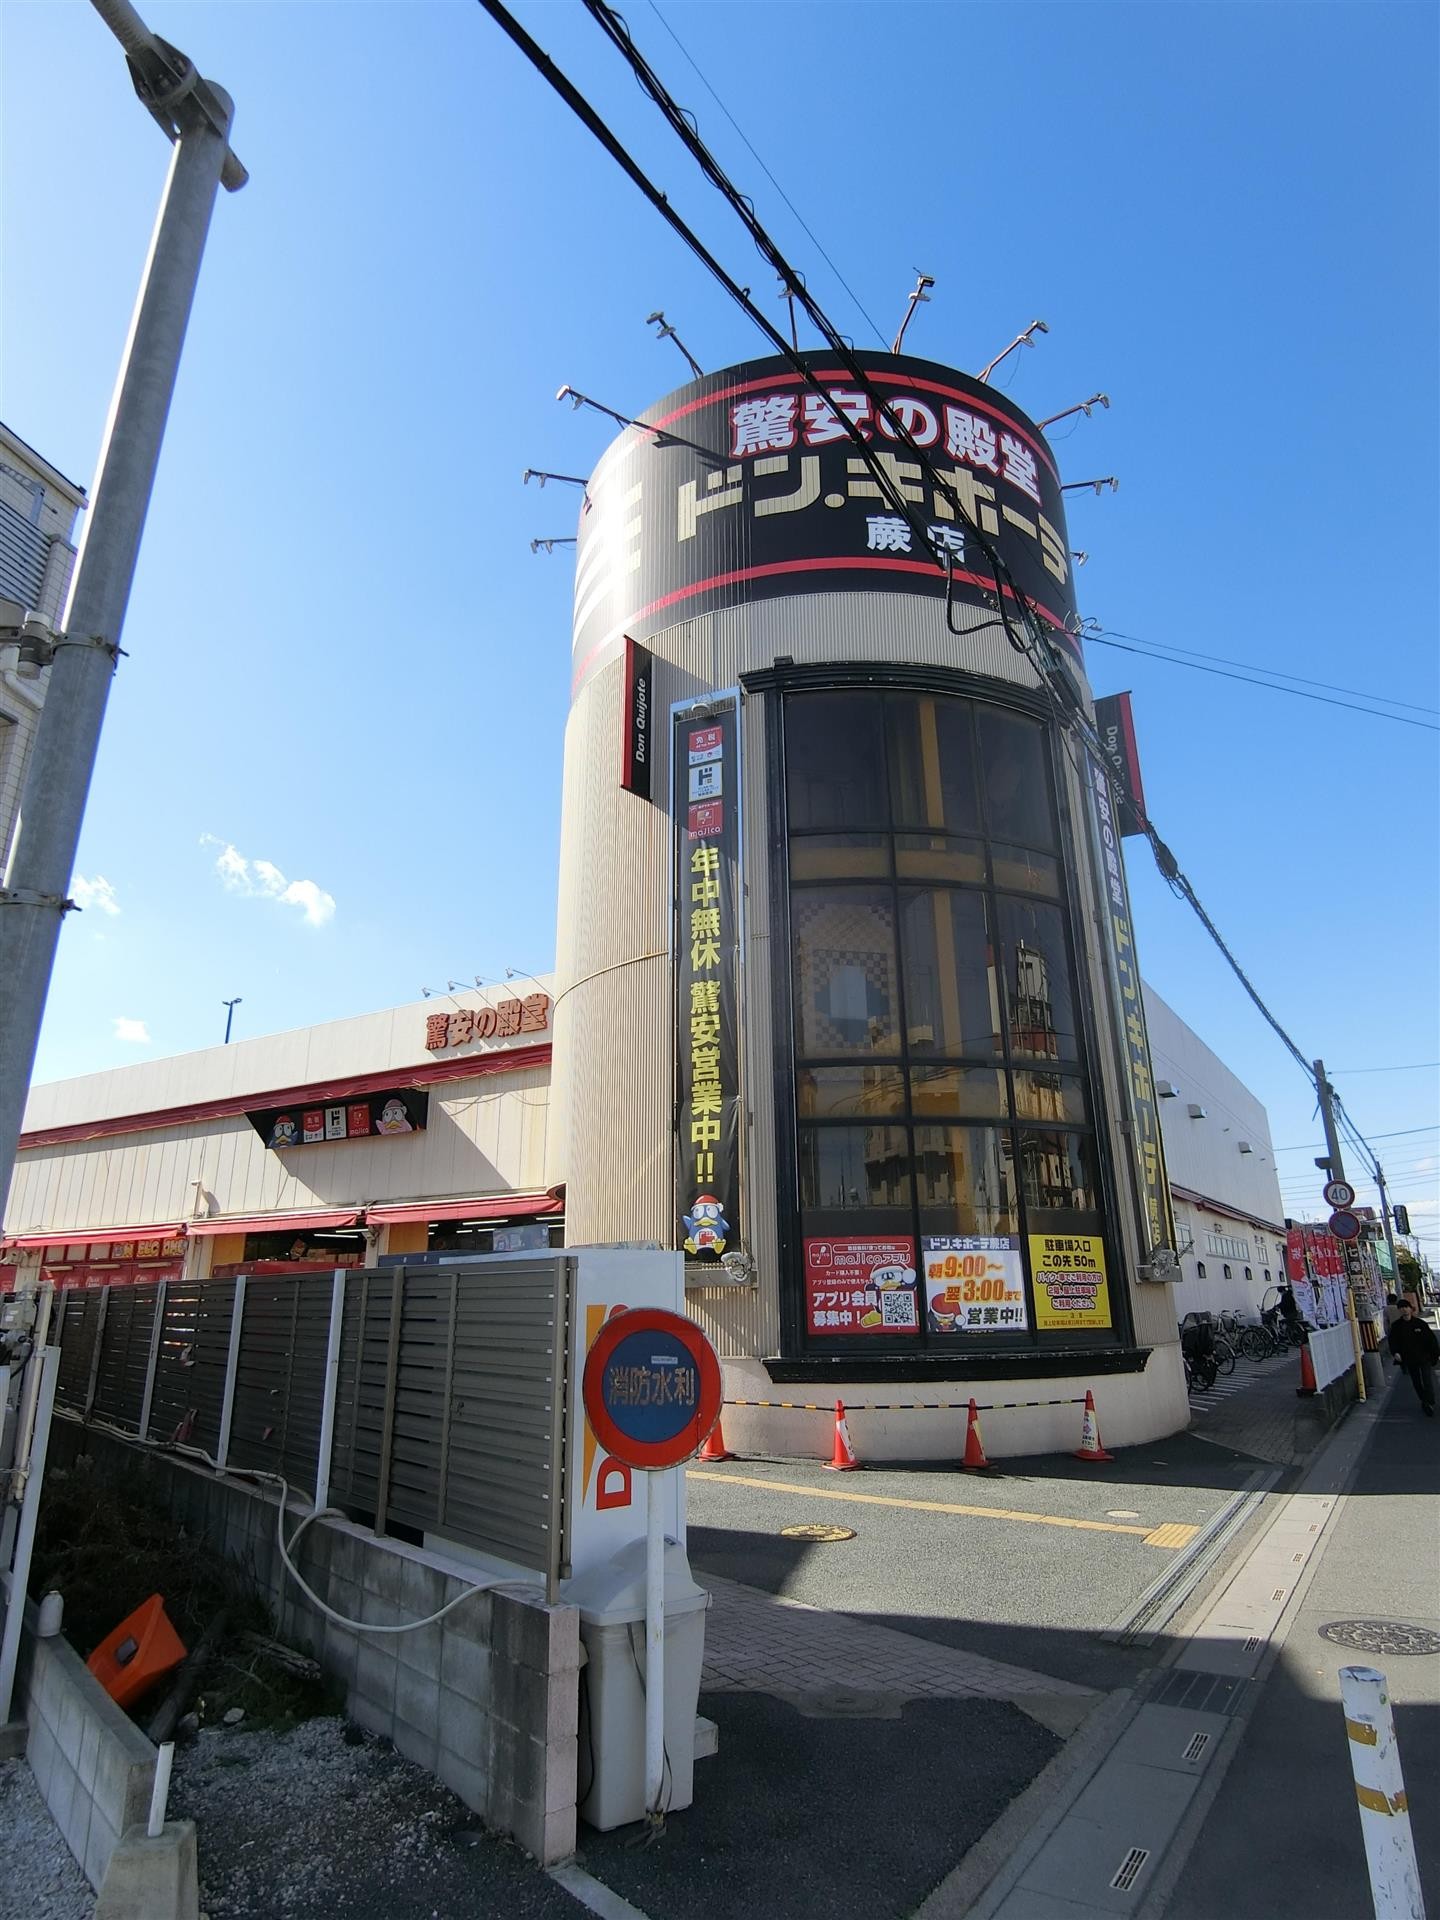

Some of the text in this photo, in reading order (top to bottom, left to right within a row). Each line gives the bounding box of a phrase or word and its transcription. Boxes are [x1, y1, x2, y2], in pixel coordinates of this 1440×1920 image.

[732, 389, 1041, 505] 驚安の殿堂
[635, 677, 649, 763] Don Quijote
[690, 826, 721, 838] majica
[690, 846, 721, 972] 年中無休
[425, 992, 549, 1051] 驚安の殿堂
[1331, 1187, 1348, 1201] 40
[1044, 1239, 1091, 1252] 駐車場入口
[812, 1290, 878, 1307] アプリ会員
[608, 1365, 695, 1406] 消防水利
